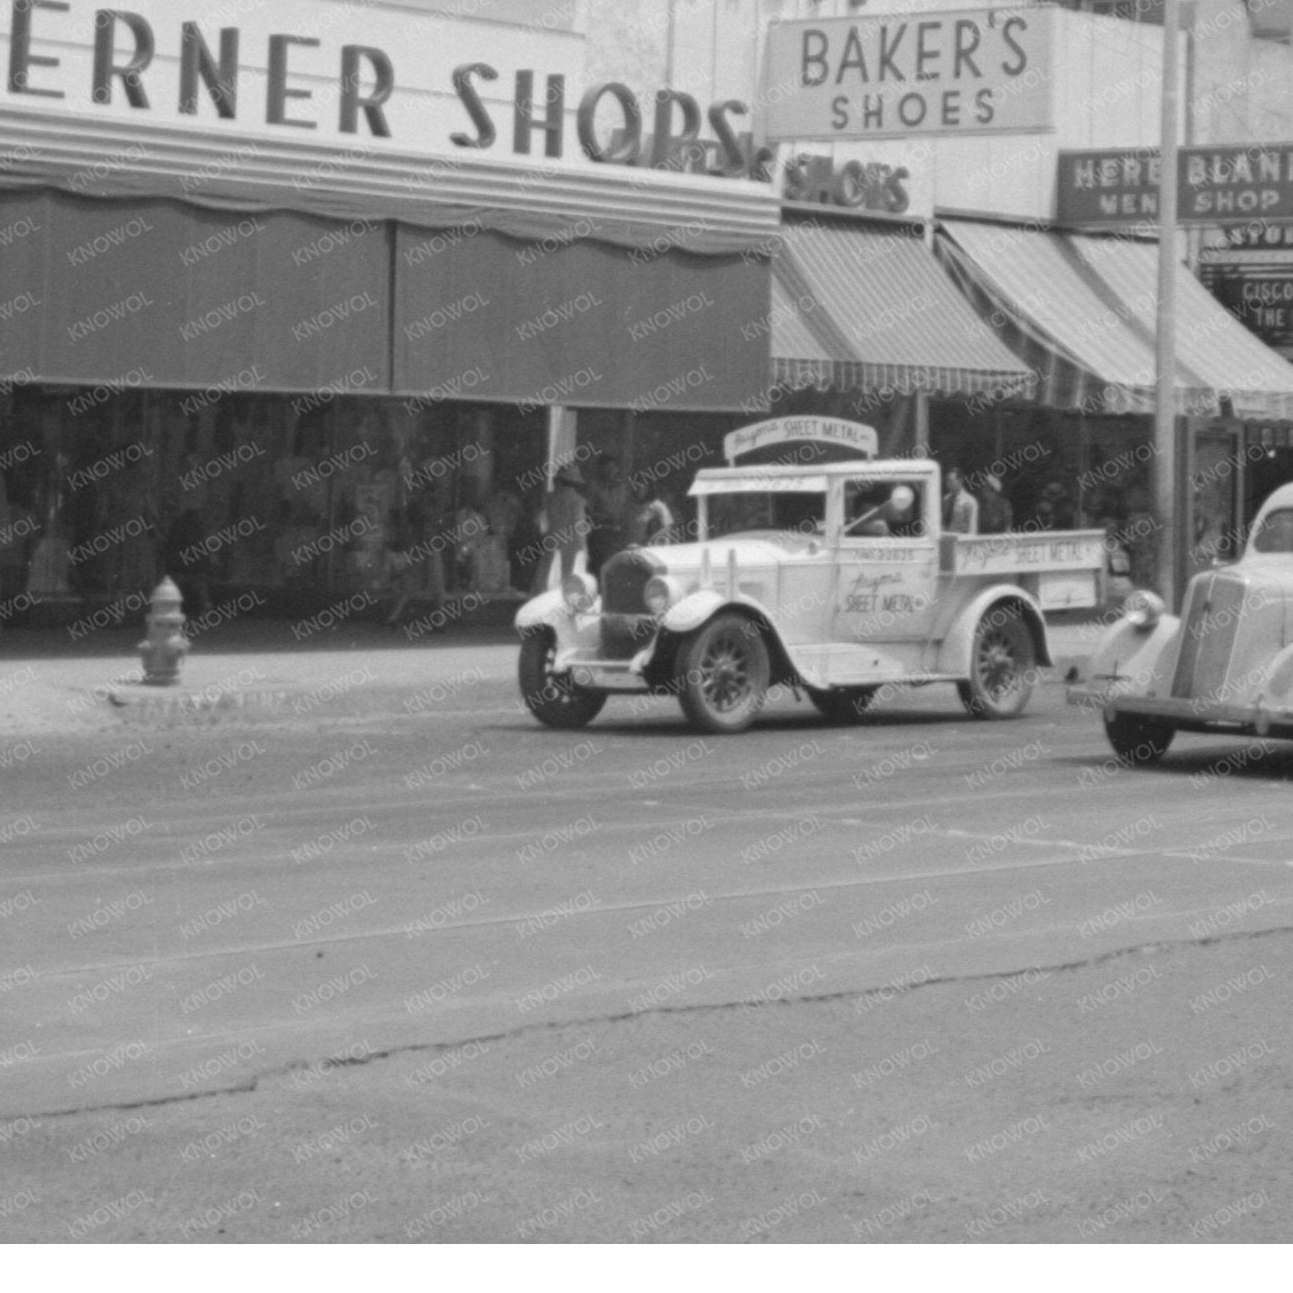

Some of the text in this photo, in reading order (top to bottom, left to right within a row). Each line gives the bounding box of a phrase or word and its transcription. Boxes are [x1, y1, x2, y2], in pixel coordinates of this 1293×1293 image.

[801, 10, 1029, 88] BAKER'S
[449, 62, 750, 178] SHOPS
[831, 87, 995, 130] SHOES
[1194, 190, 1280, 213] SHOP
[1243, 282, 1293, 301] CISCO
[1256, 309, 1285, 327] THE
[784, 419, 819, 439] SHEET
[822, 422, 859, 442] METAL
[1015, 543, 1047, 564] SHEET
[1050, 541, 1083, 562] METAL
[845, 594, 878, 613] SHEET
[882, 594, 915, 613] METAL
